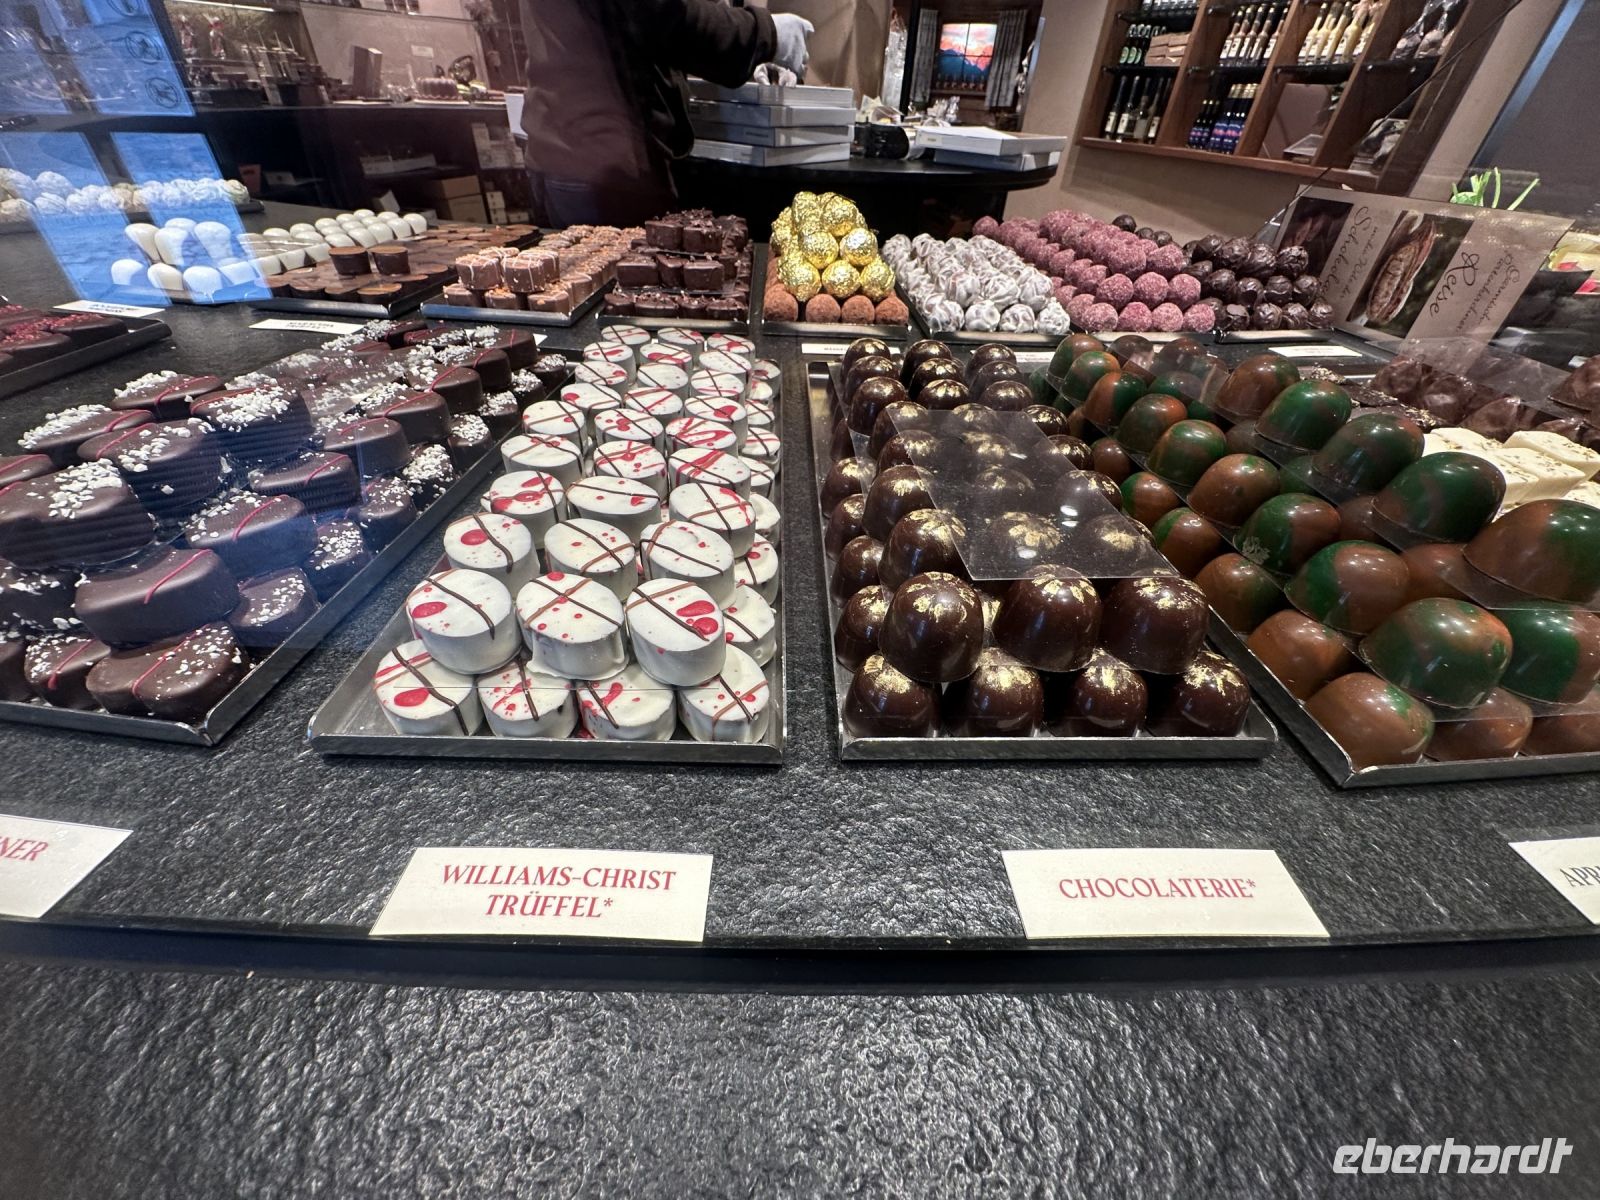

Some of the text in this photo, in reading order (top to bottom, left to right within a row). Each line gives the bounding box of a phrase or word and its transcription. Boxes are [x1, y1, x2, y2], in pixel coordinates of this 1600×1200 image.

[1313, 206, 1372, 302] Schokolad
[1430, 252, 1479, 317] Reise
[443, 865, 676, 890] WILLIAMS-CHRIST
[1560, 866, 1600, 887] APR
